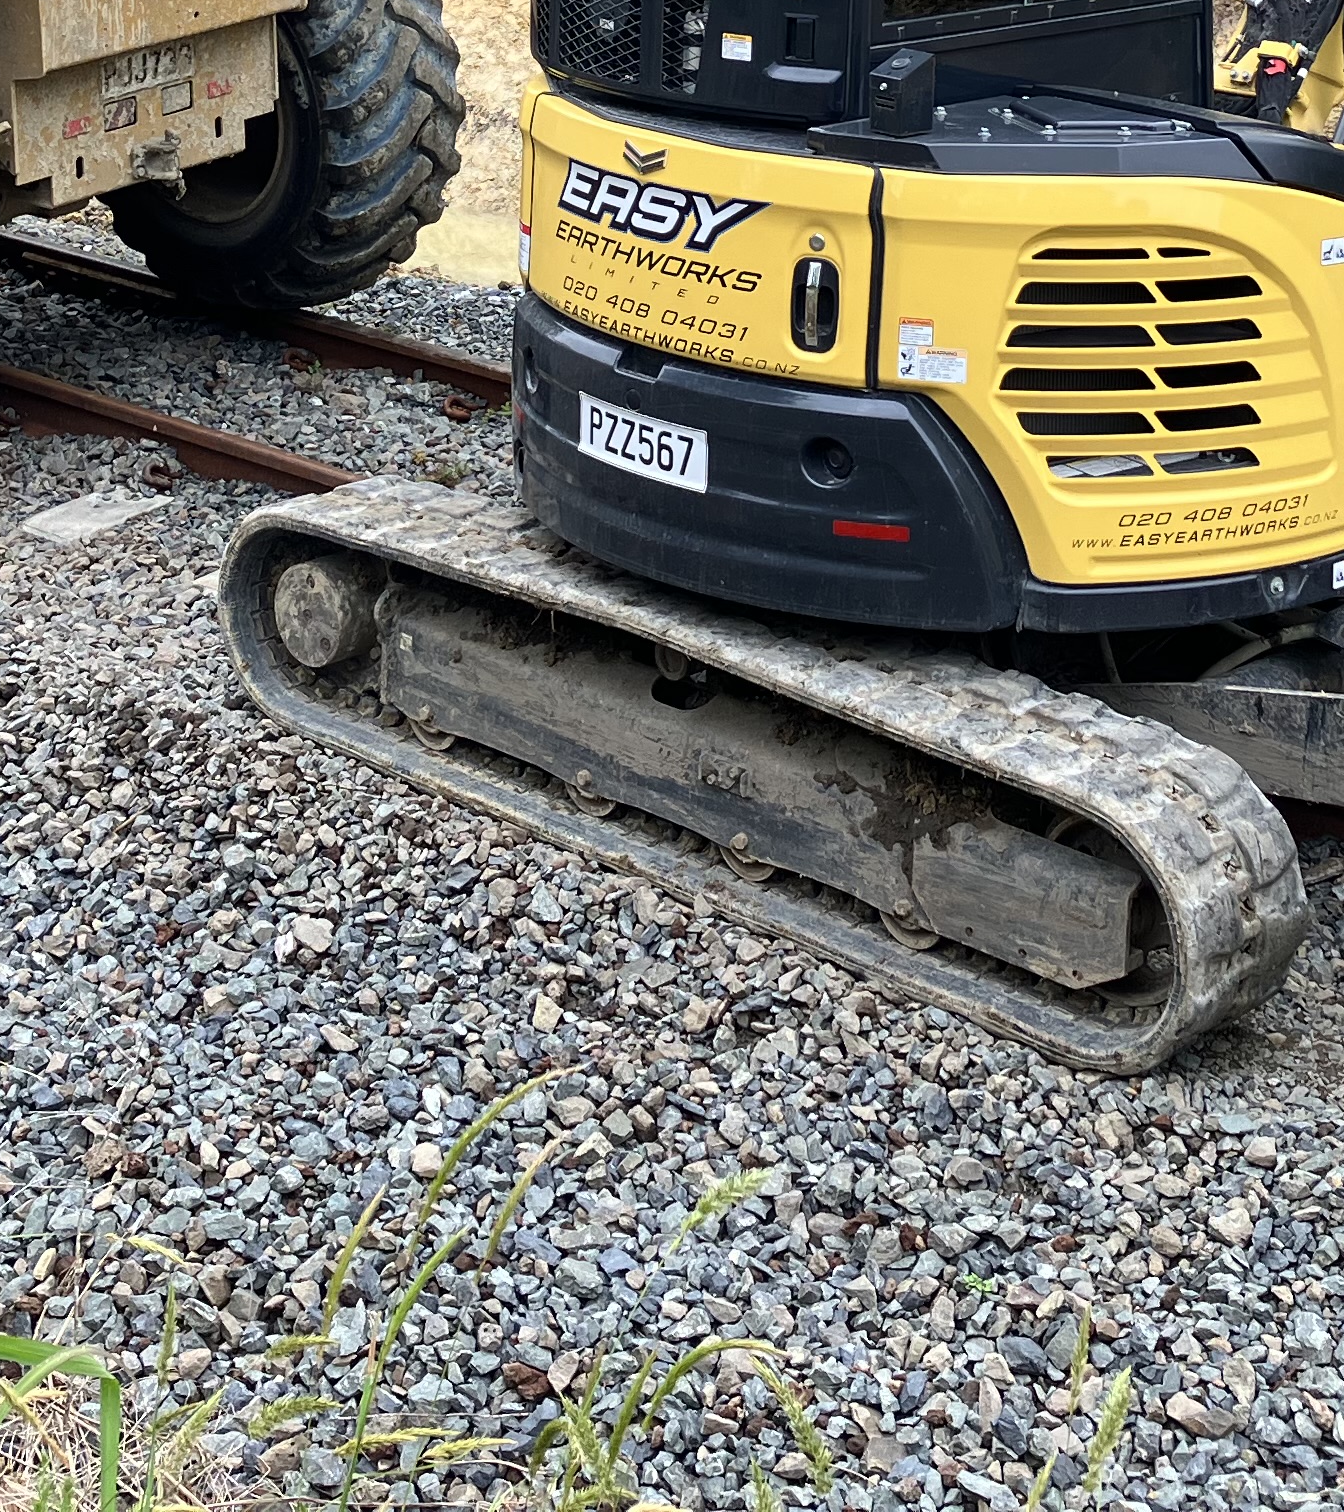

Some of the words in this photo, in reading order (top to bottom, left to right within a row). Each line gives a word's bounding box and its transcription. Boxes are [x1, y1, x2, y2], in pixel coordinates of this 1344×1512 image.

[558, 158, 772, 253] EASY
[555, 219, 763, 293] EARTHWORKS
[570, 253, 720, 305] LIMITED
[563, 275, 598, 301] 020
[605, 294, 651, 319] 408
[660, 309, 750, 342] 04031
[589, 404, 694, 476] PZZ567
[1118, 512, 1173, 528] 020
[1183, 506, 1233, 524] 408
[1241, 493, 1310, 518] 04031
